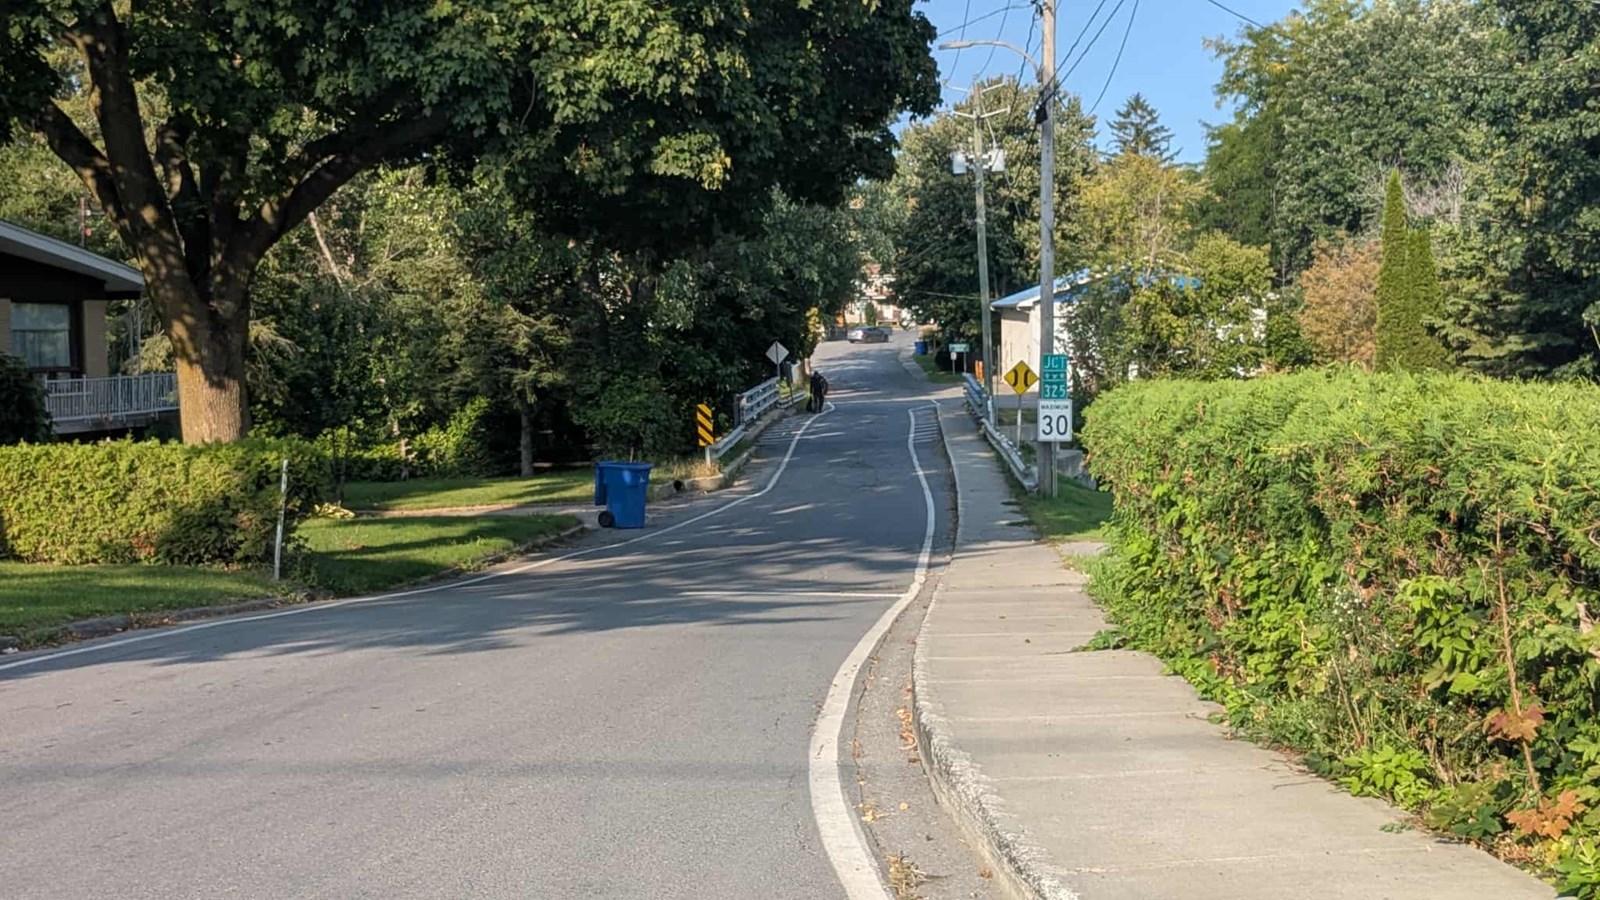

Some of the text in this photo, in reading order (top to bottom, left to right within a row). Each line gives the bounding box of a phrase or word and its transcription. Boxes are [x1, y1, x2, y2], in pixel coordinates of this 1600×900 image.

[1044, 356, 1067, 369] JCT
[1044, 385, 1066, 397] 325
[1042, 415, 1068, 435] 30
